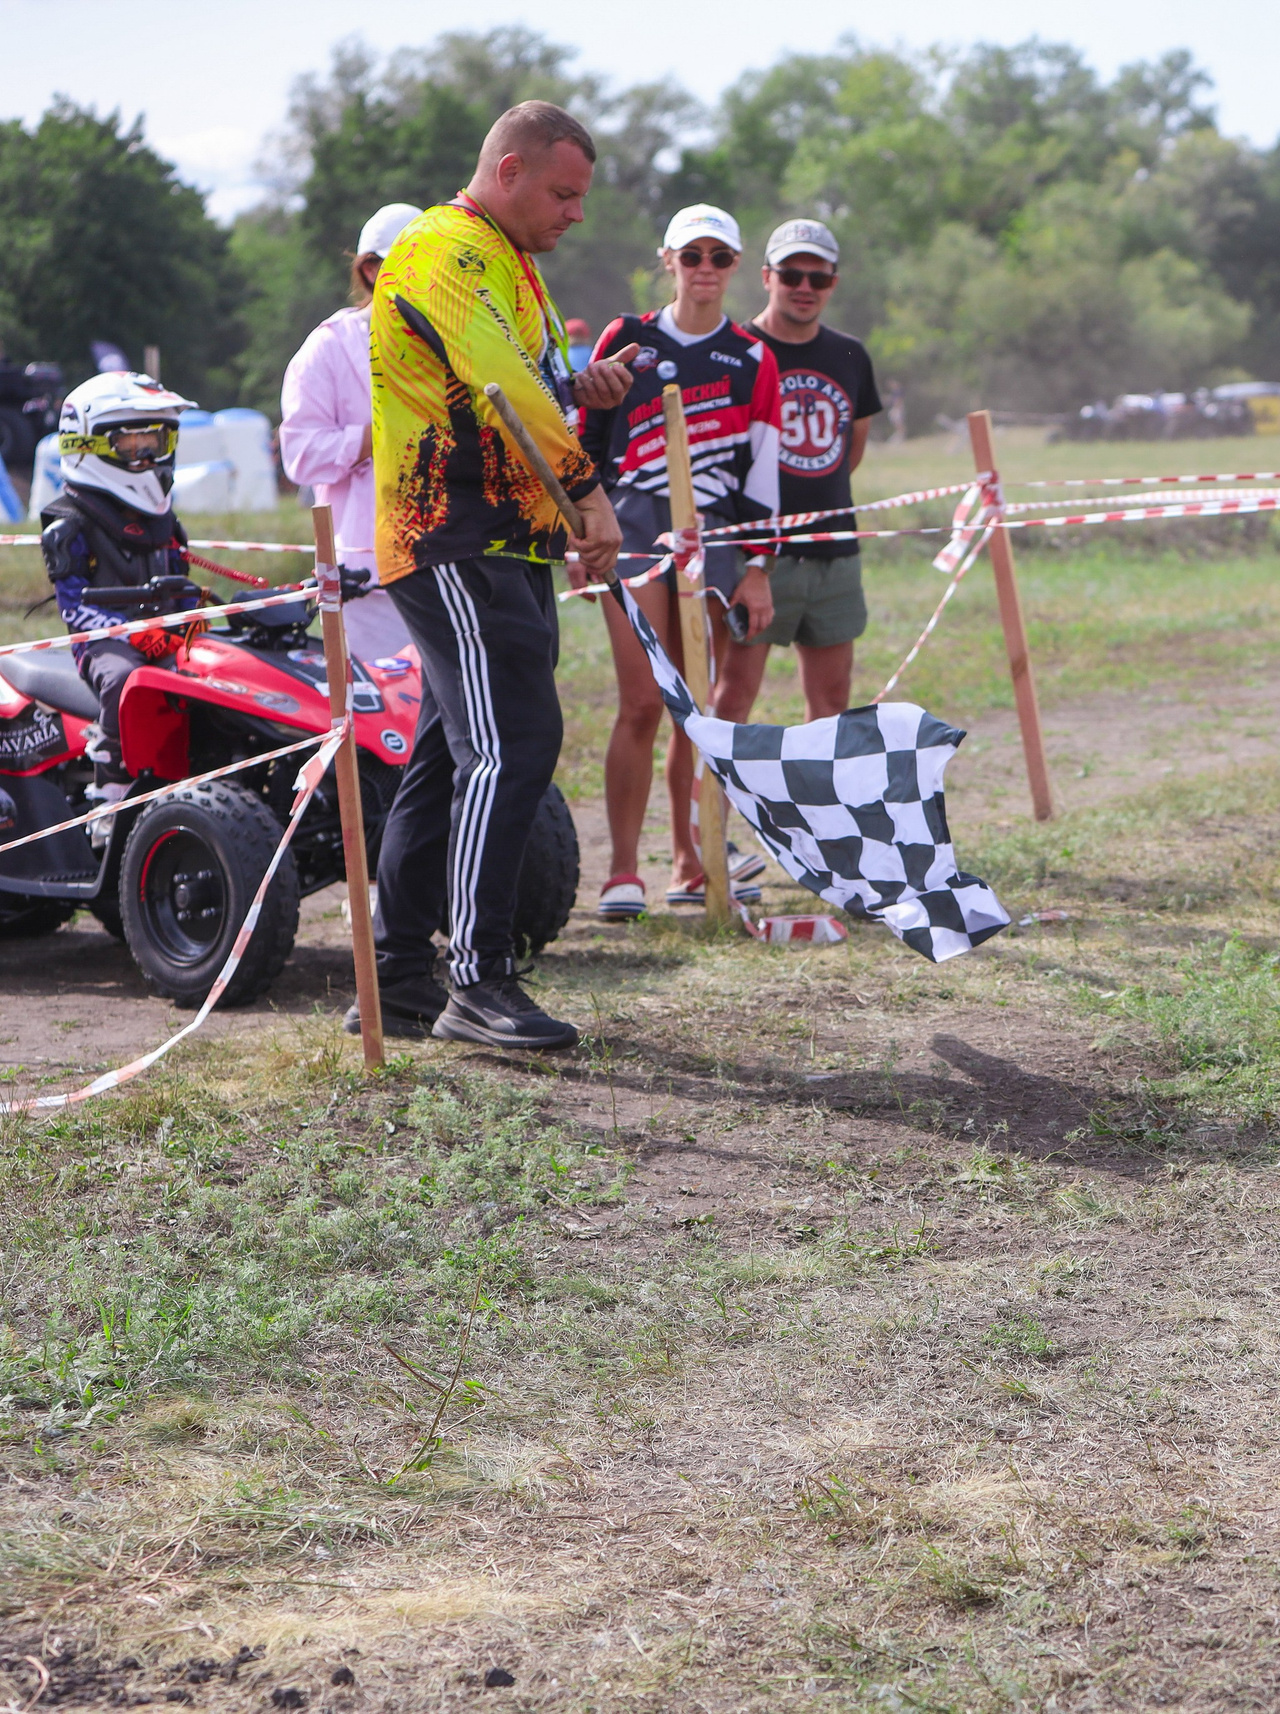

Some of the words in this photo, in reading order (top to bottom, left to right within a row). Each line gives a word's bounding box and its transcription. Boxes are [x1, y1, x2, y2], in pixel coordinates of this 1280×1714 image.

[778, 374, 819, 396] POLO
[627, 374, 731, 428] УЛЬЯВСКИЙ
[0, 722, 60, 753] AVARIA
